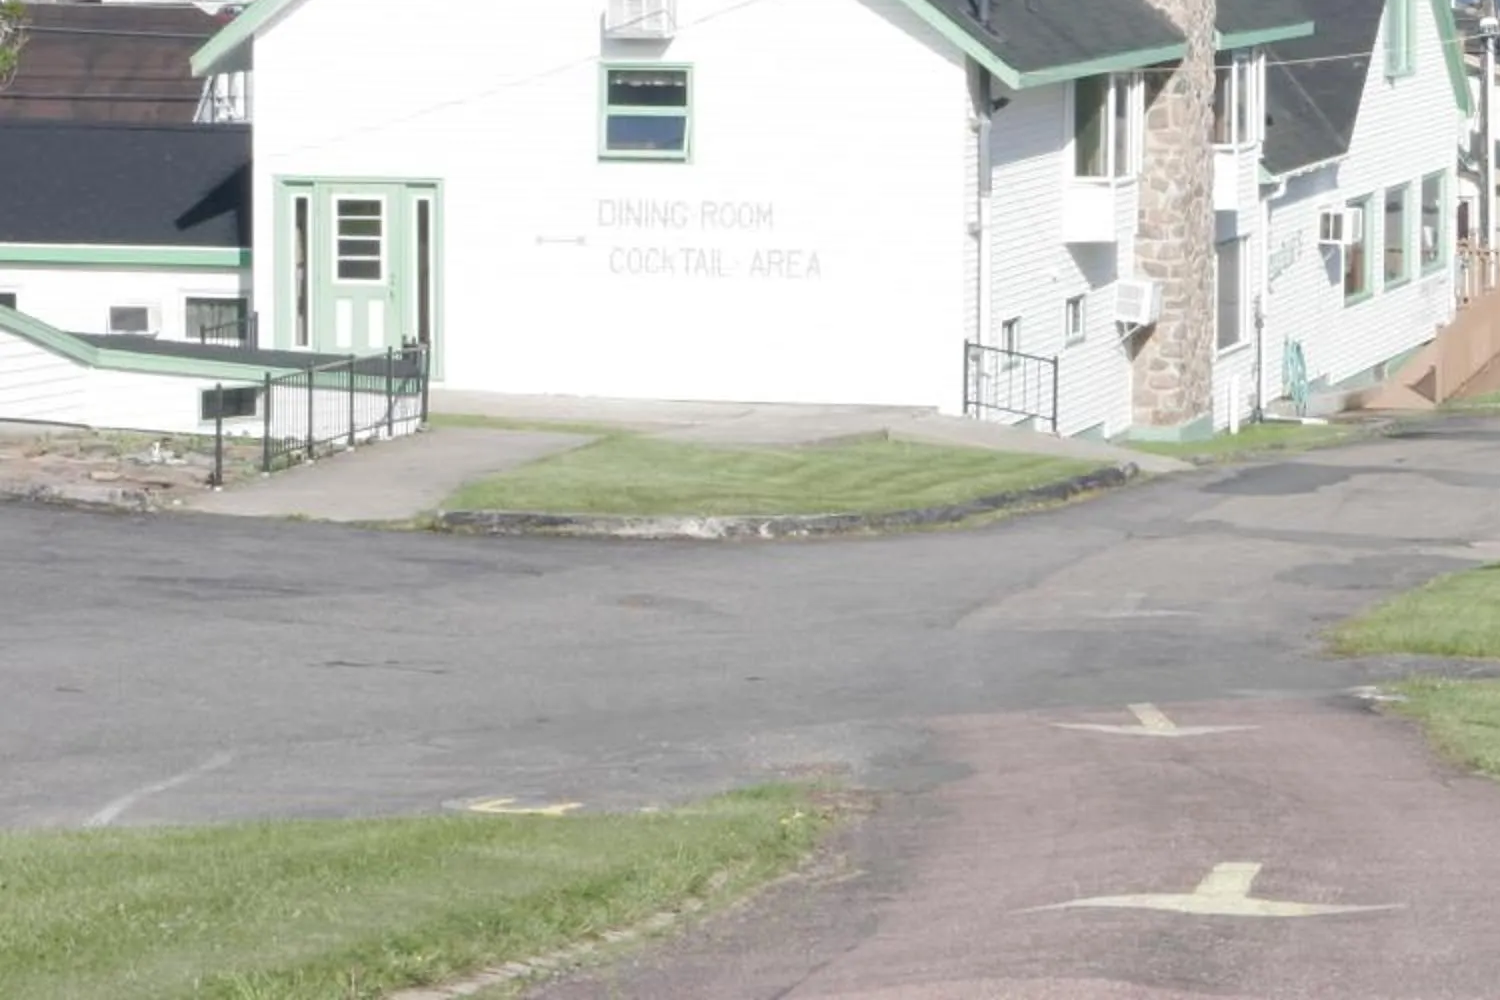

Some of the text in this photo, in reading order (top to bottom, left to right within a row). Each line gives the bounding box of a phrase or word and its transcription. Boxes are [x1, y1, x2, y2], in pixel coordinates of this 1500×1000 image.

[597, 198, 774, 229] DINING ROOM
[609, 247, 821, 280] COCKTAIL AREA
